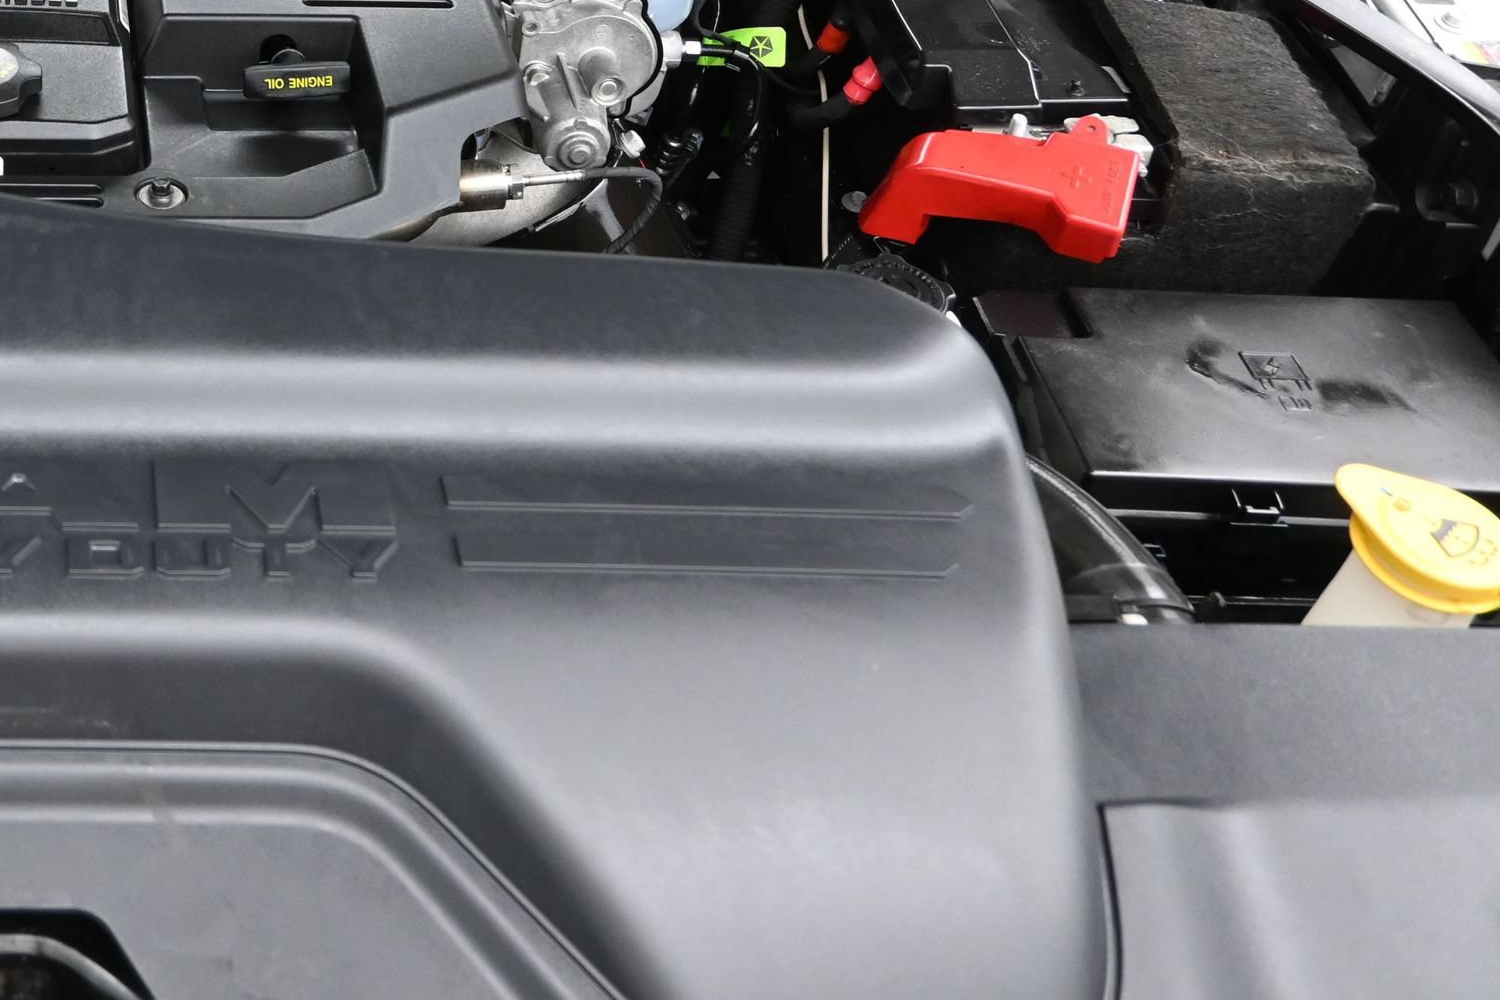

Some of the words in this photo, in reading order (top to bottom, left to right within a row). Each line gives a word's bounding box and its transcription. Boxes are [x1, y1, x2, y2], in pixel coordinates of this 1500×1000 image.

[264, 78, 285, 90] OIL
[288, 75, 333, 89] ENGINE
[65, 537, 400, 582] DUTY
